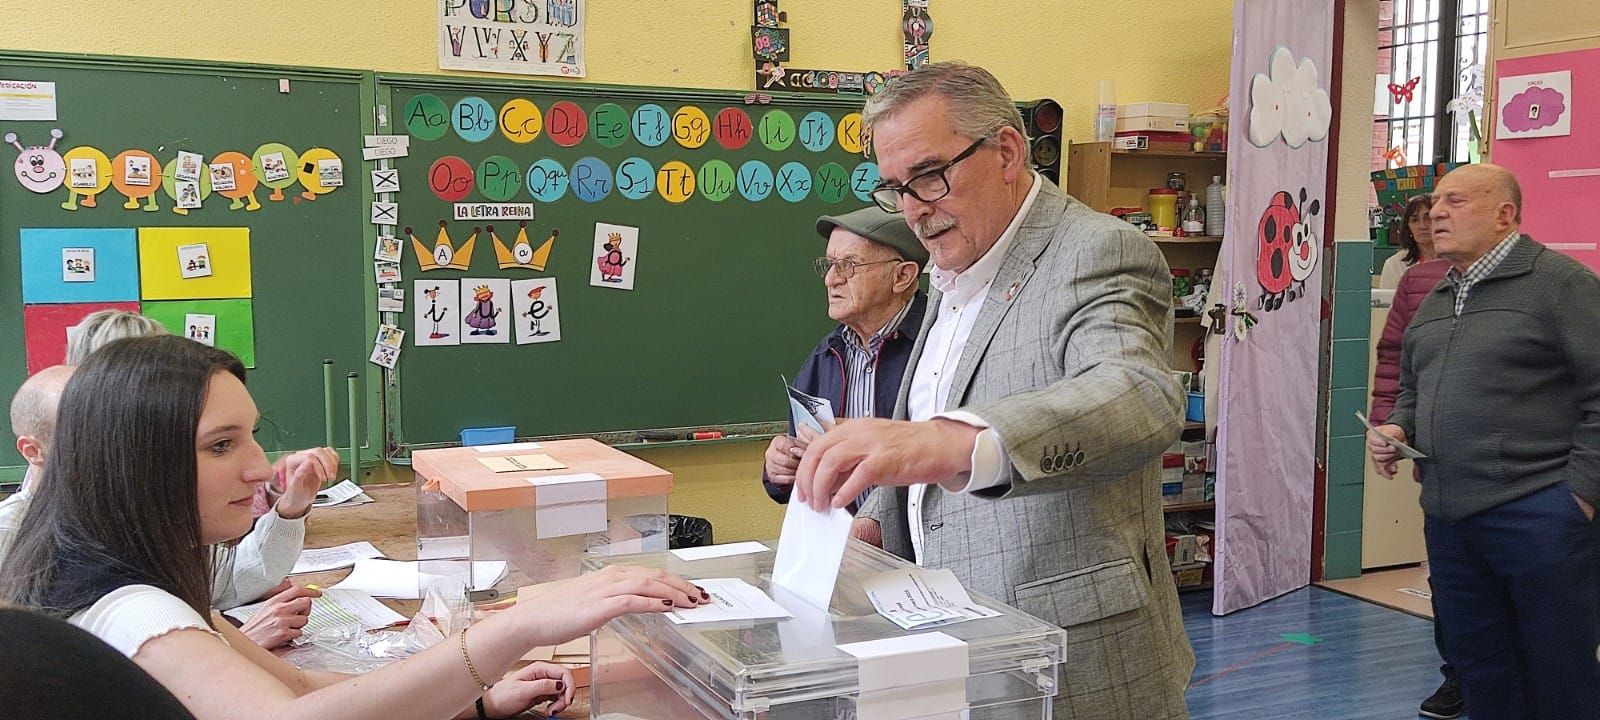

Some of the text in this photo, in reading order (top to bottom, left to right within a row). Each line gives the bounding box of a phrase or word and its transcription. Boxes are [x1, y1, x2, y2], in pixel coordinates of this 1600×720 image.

[458, 205, 530, 217] LA LETRA REINA
[438, 248, 447, 260] A
[519, 249, 529, 258] a
